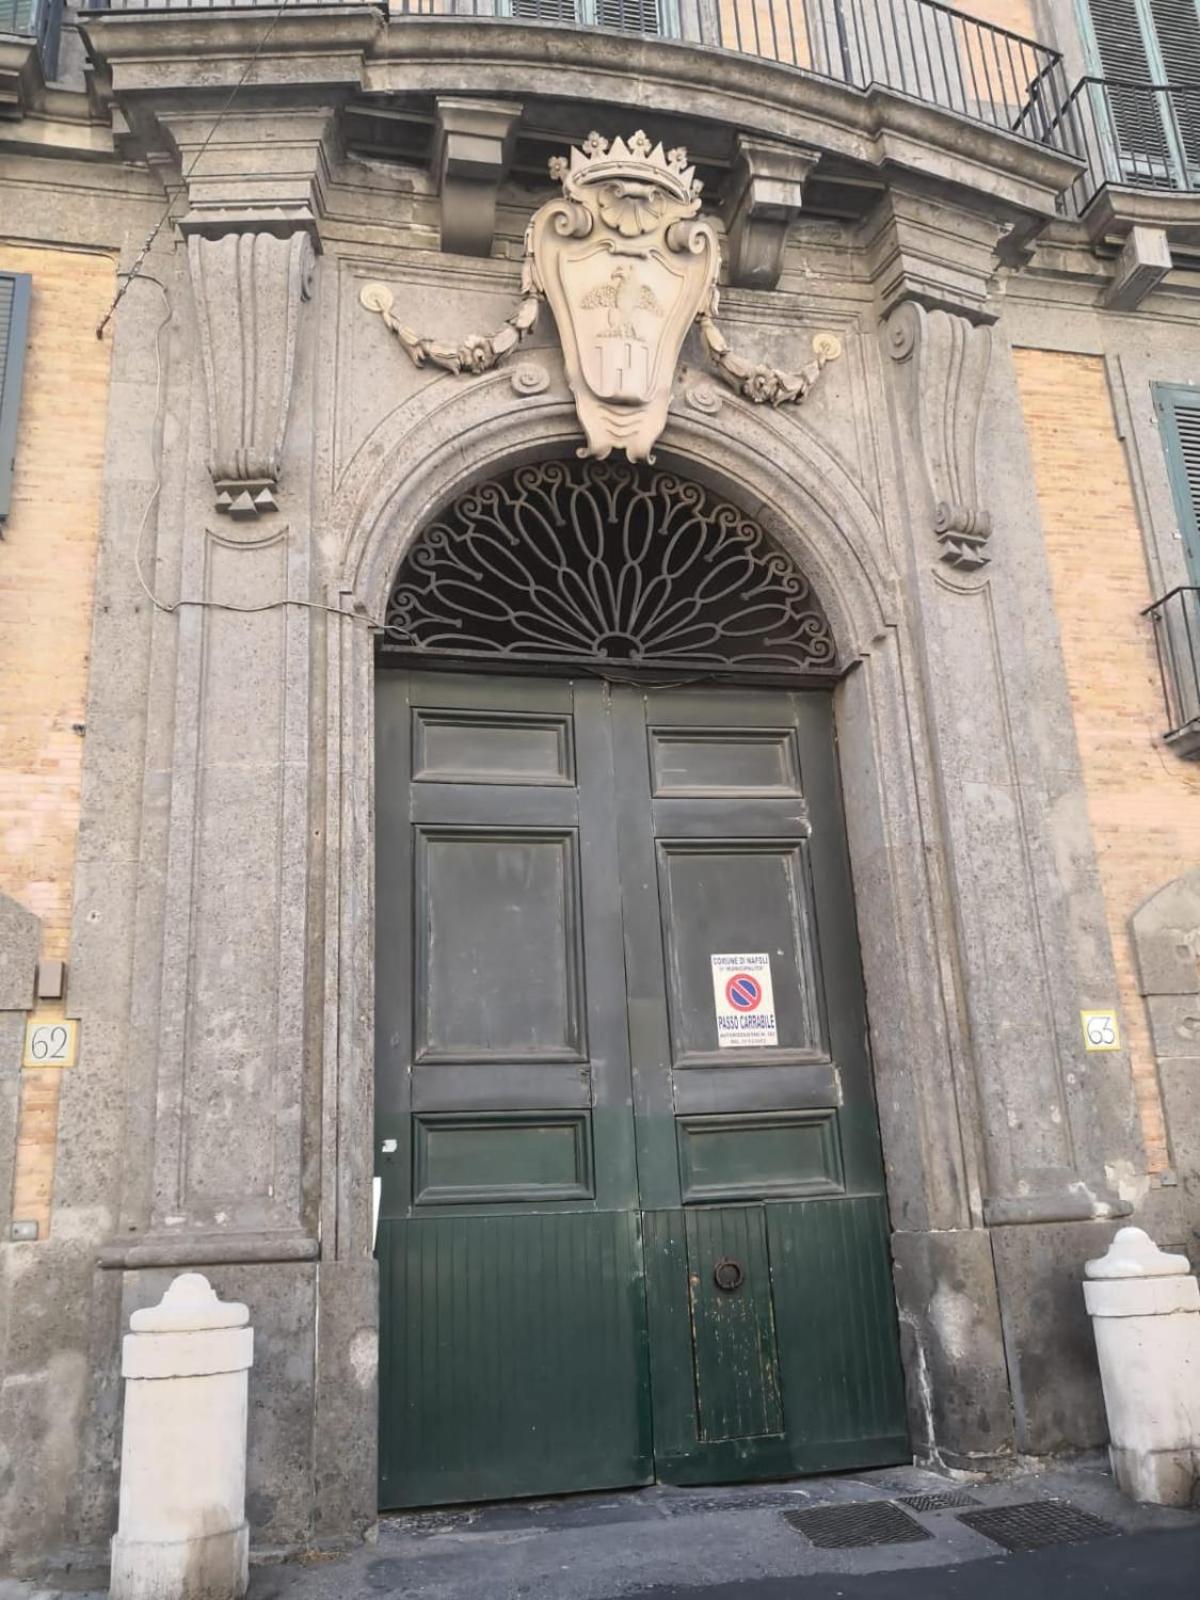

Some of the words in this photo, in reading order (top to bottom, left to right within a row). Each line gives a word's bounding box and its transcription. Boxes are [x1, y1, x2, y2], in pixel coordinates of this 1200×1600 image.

[713, 957, 738, 965] COMUNE
[739, 957, 746, 965] DI
[747, 956, 768, 964] NAPOLI
[718, 1016, 739, 1030] PASSO
[740, 1014, 775, 1029] CARRABILE
[1087, 1016, 1115, 1045] 63
[31, 1026, 67, 1059] 62
